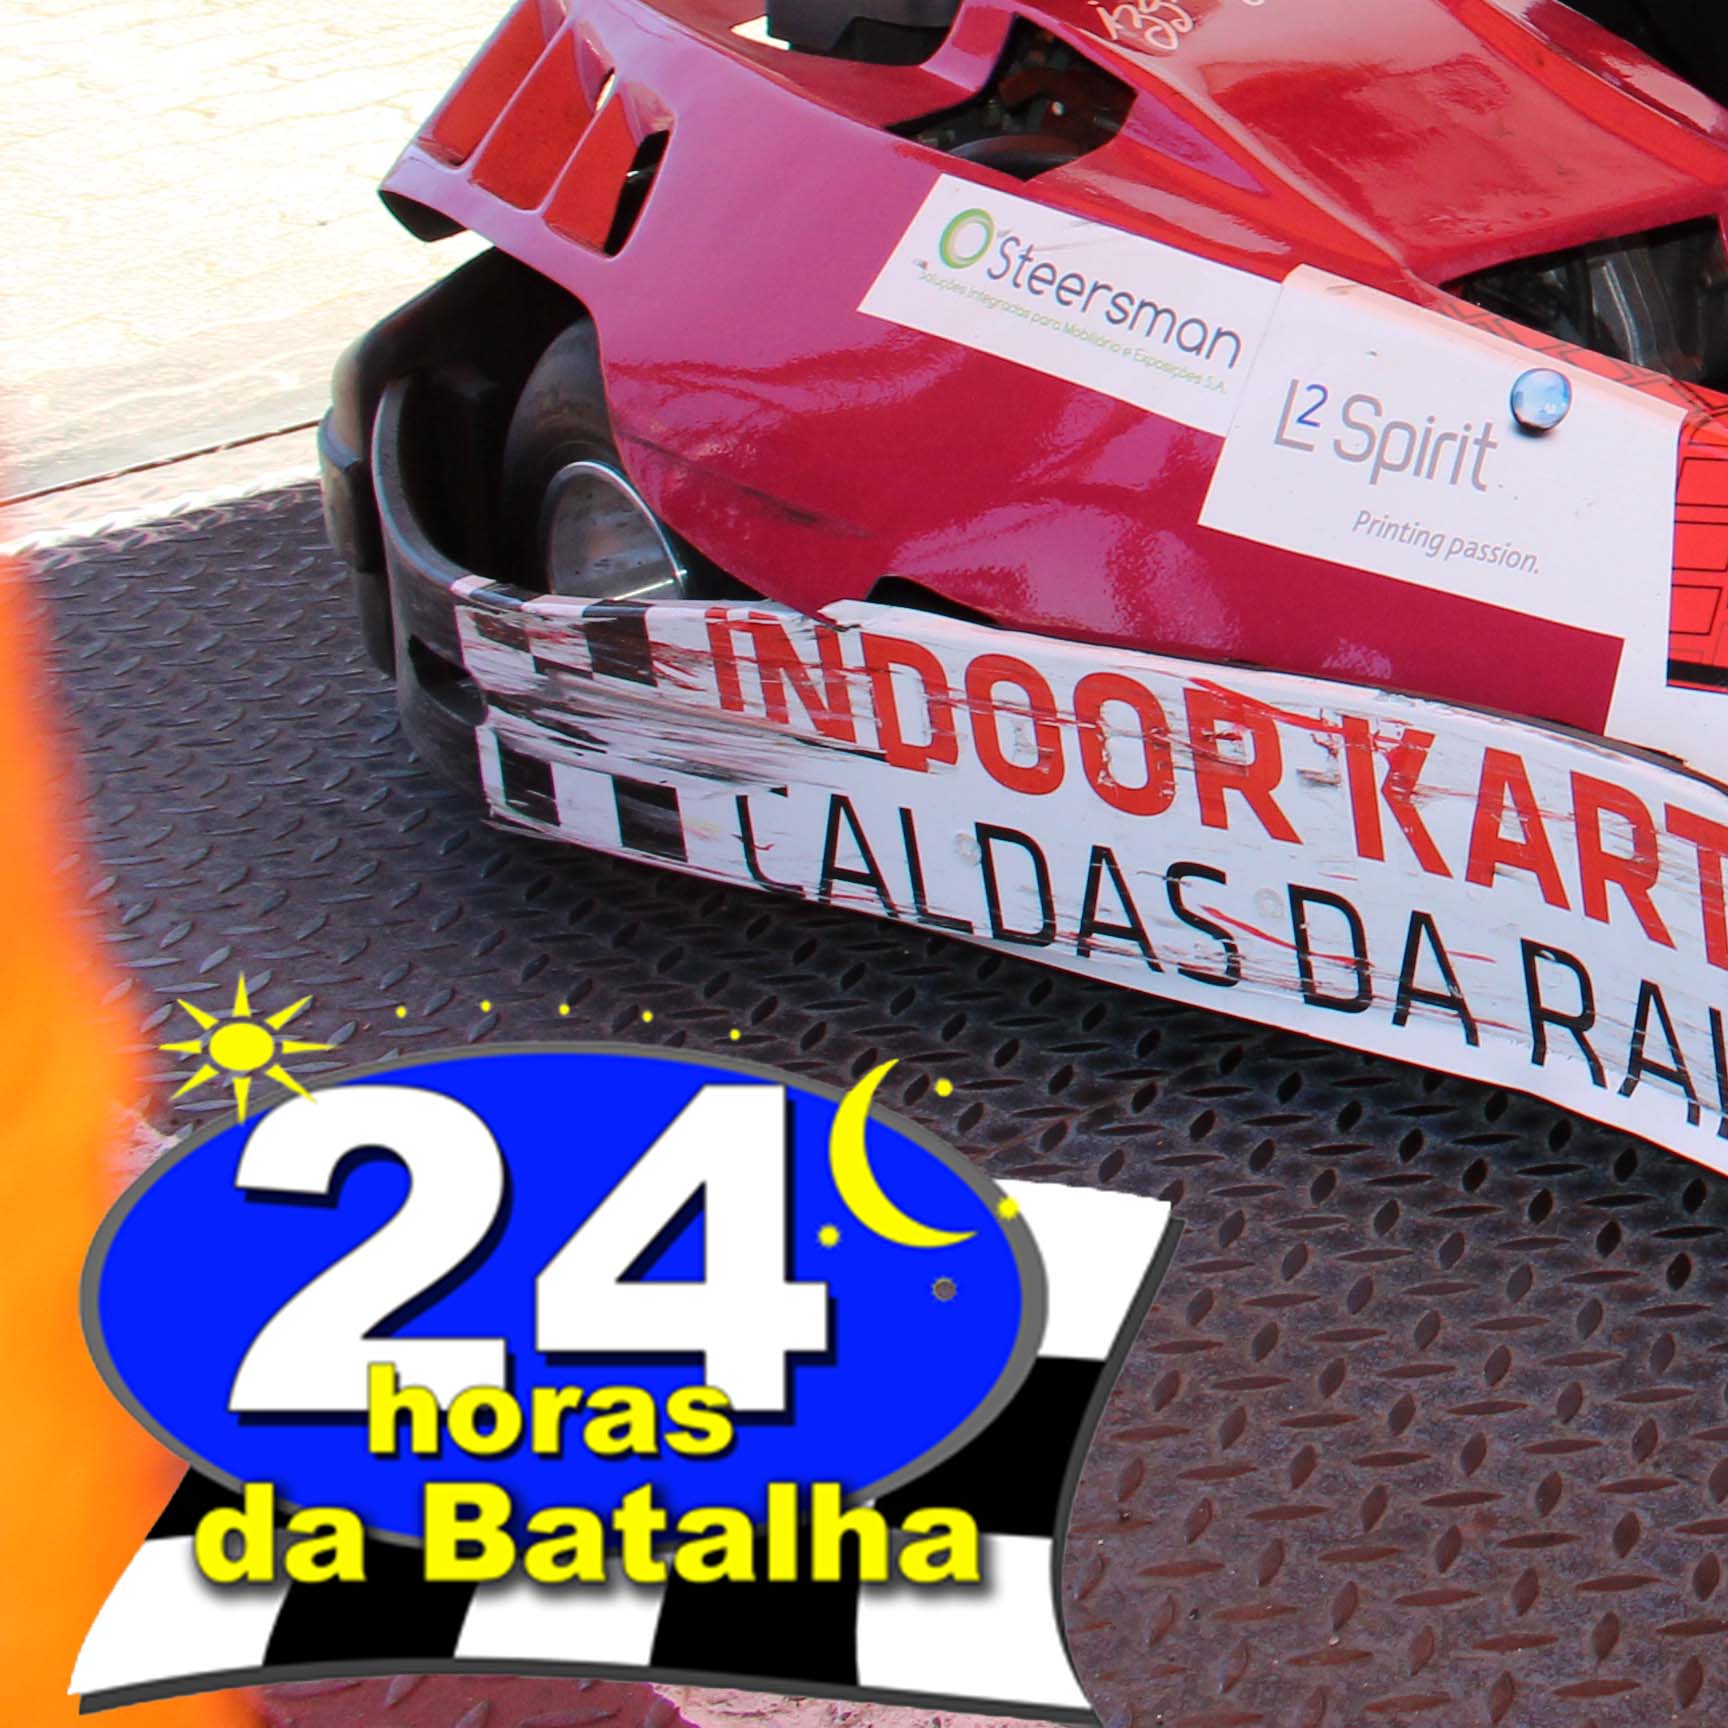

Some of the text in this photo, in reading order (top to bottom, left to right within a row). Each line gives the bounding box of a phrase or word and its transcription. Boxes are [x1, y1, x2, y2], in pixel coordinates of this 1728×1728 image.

[986, 235, 1242, 370] Steersman
[1030, 309, 1061, 332] para
[1332, 392, 1499, 493] Spirit
[1351, 509, 1541, 575] Printing passion.
[704, 607, 1300, 844] INDOOR
[734, 786, 1243, 988] CALDAS
[1285, 883, 1479, 1048] DA
